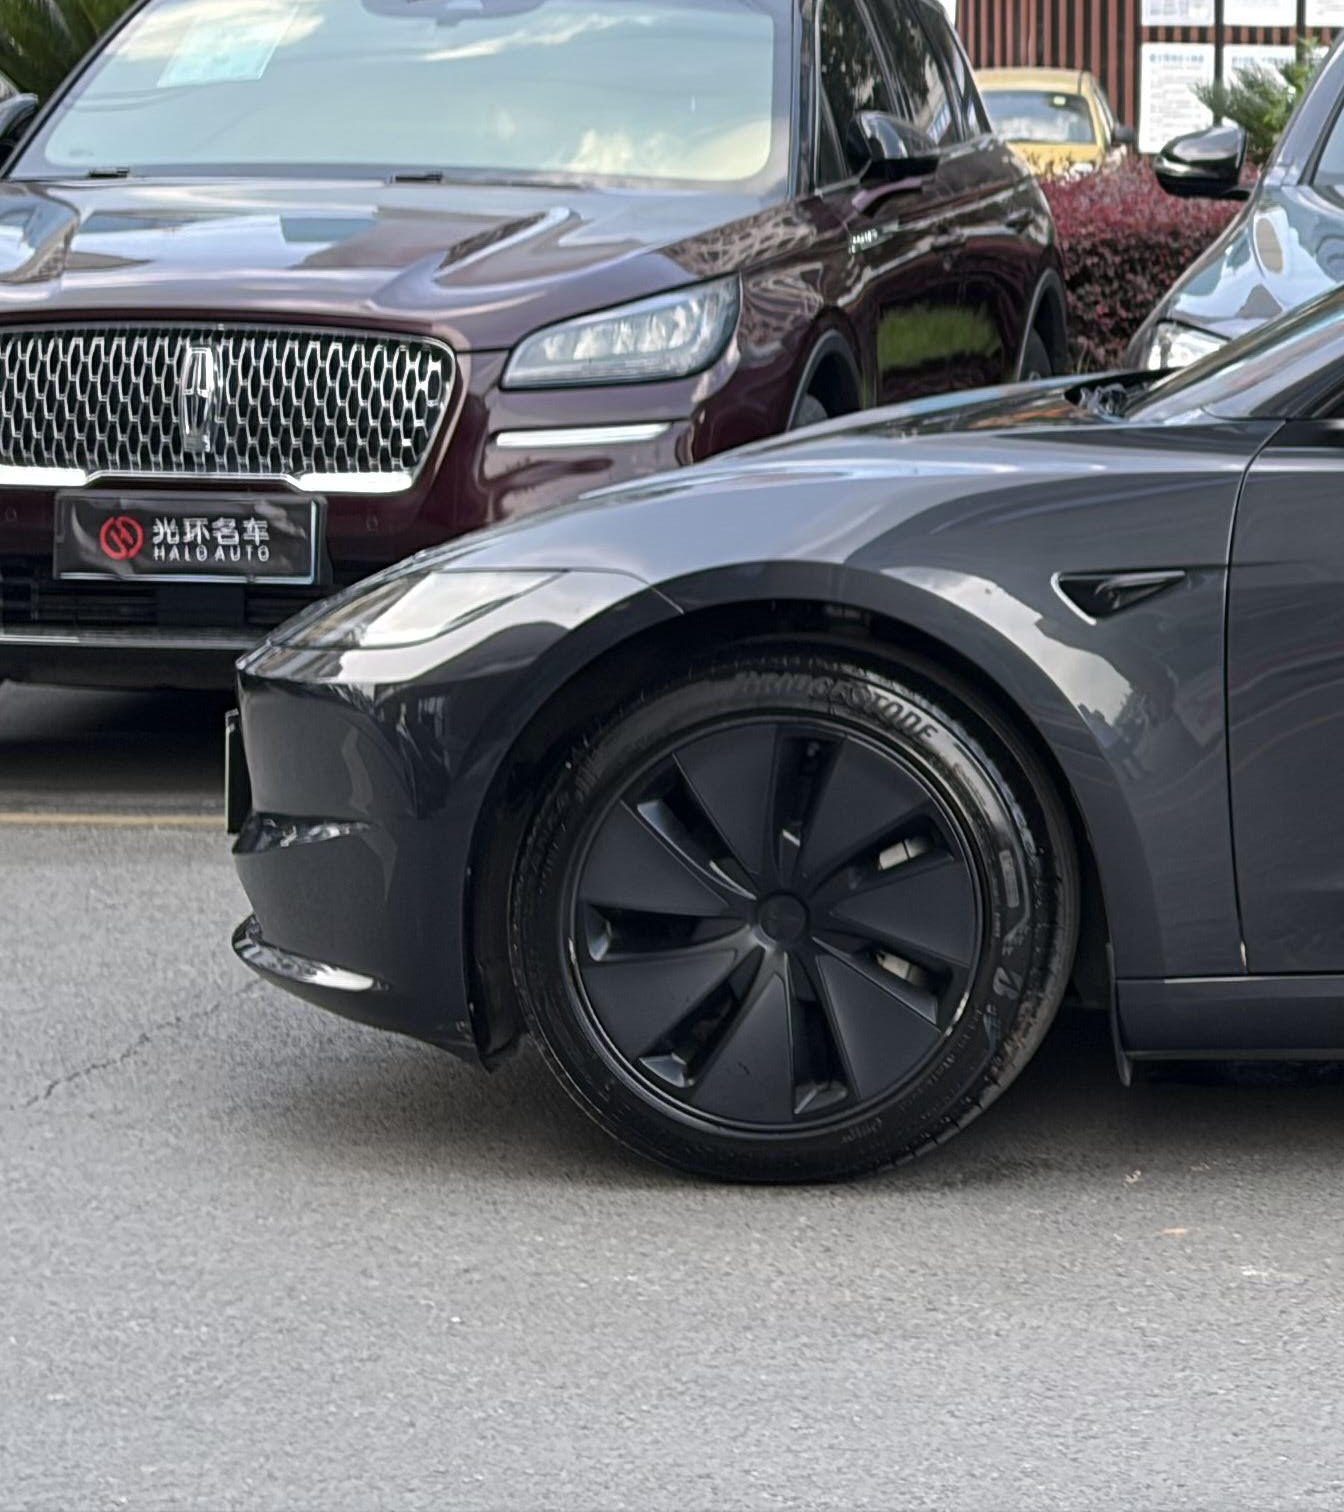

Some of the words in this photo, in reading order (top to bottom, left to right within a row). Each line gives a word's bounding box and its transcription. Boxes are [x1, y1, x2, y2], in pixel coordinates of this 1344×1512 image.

[152, 516, 270, 546] 光环名车
[153, 544, 208, 562] HALO
[214, 544, 270, 562] AUTO
